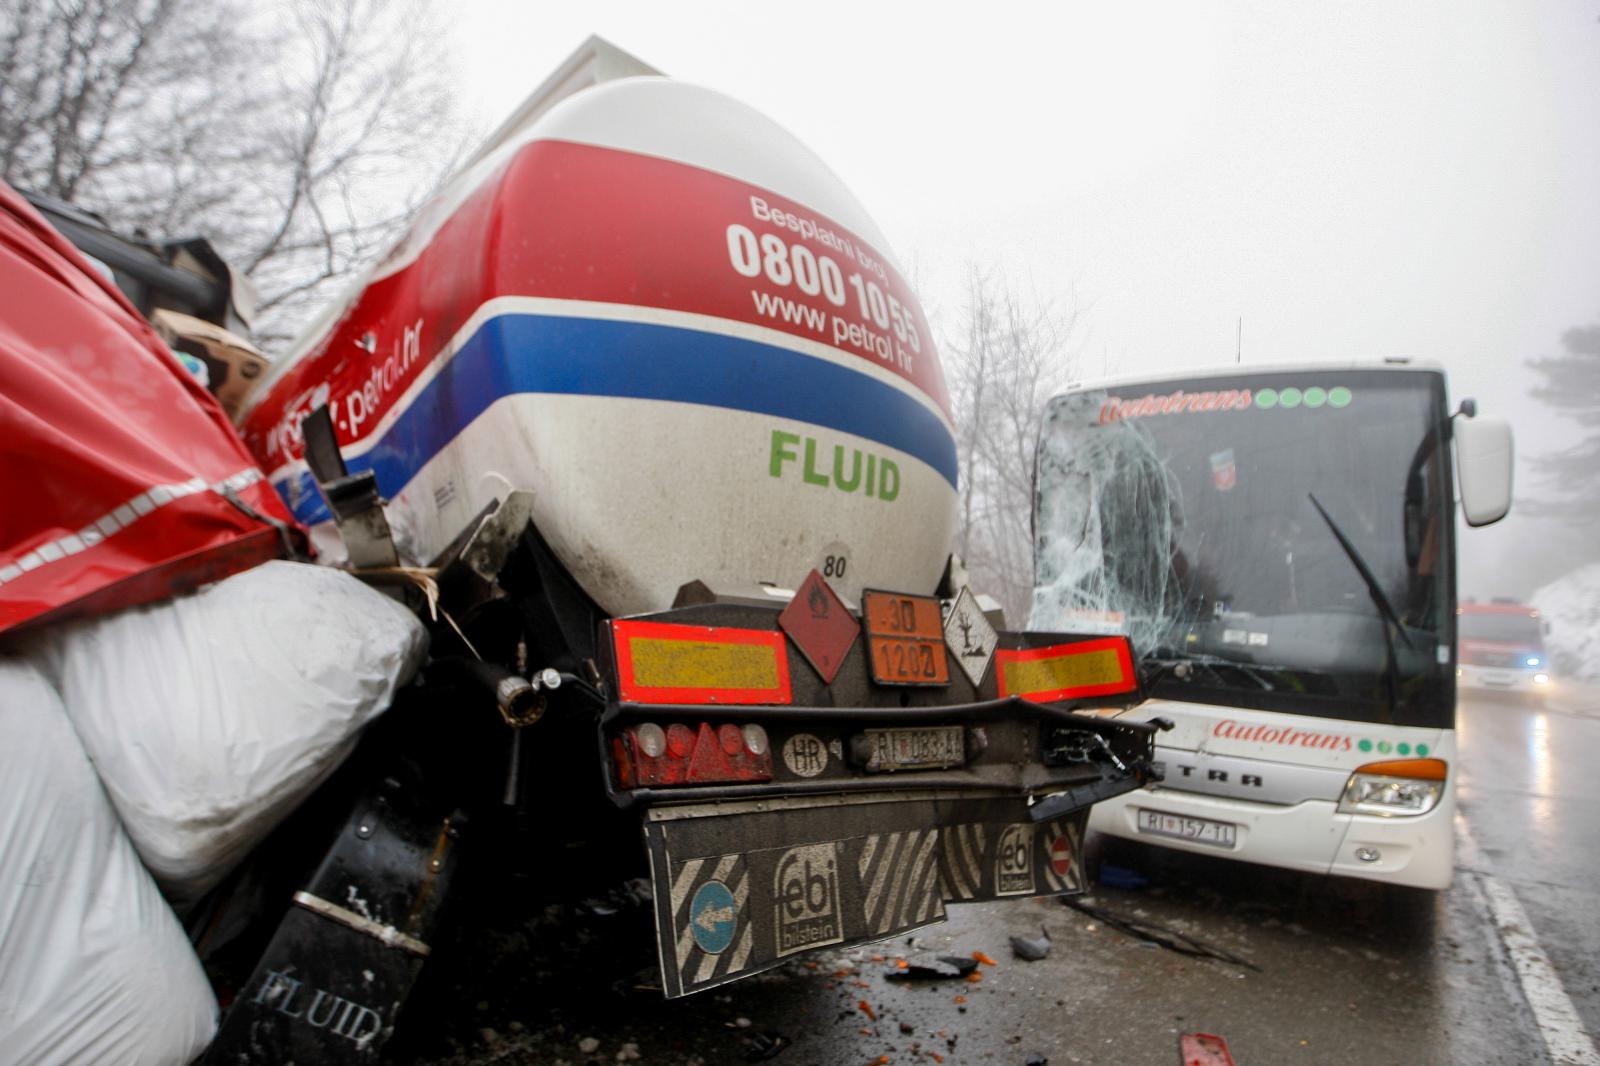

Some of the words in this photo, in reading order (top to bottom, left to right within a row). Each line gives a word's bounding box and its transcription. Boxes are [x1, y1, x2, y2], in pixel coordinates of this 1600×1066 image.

[750, 195, 855, 259] Besplatni
[726, 223, 846, 307] 0800
[769, 429, 900, 502] FLUID
[823, 555, 846, 578] 80
[881, 643, 937, 678] 1202
[792, 739, 822, 771] HR
[253, 970, 383, 1043] FLUID
